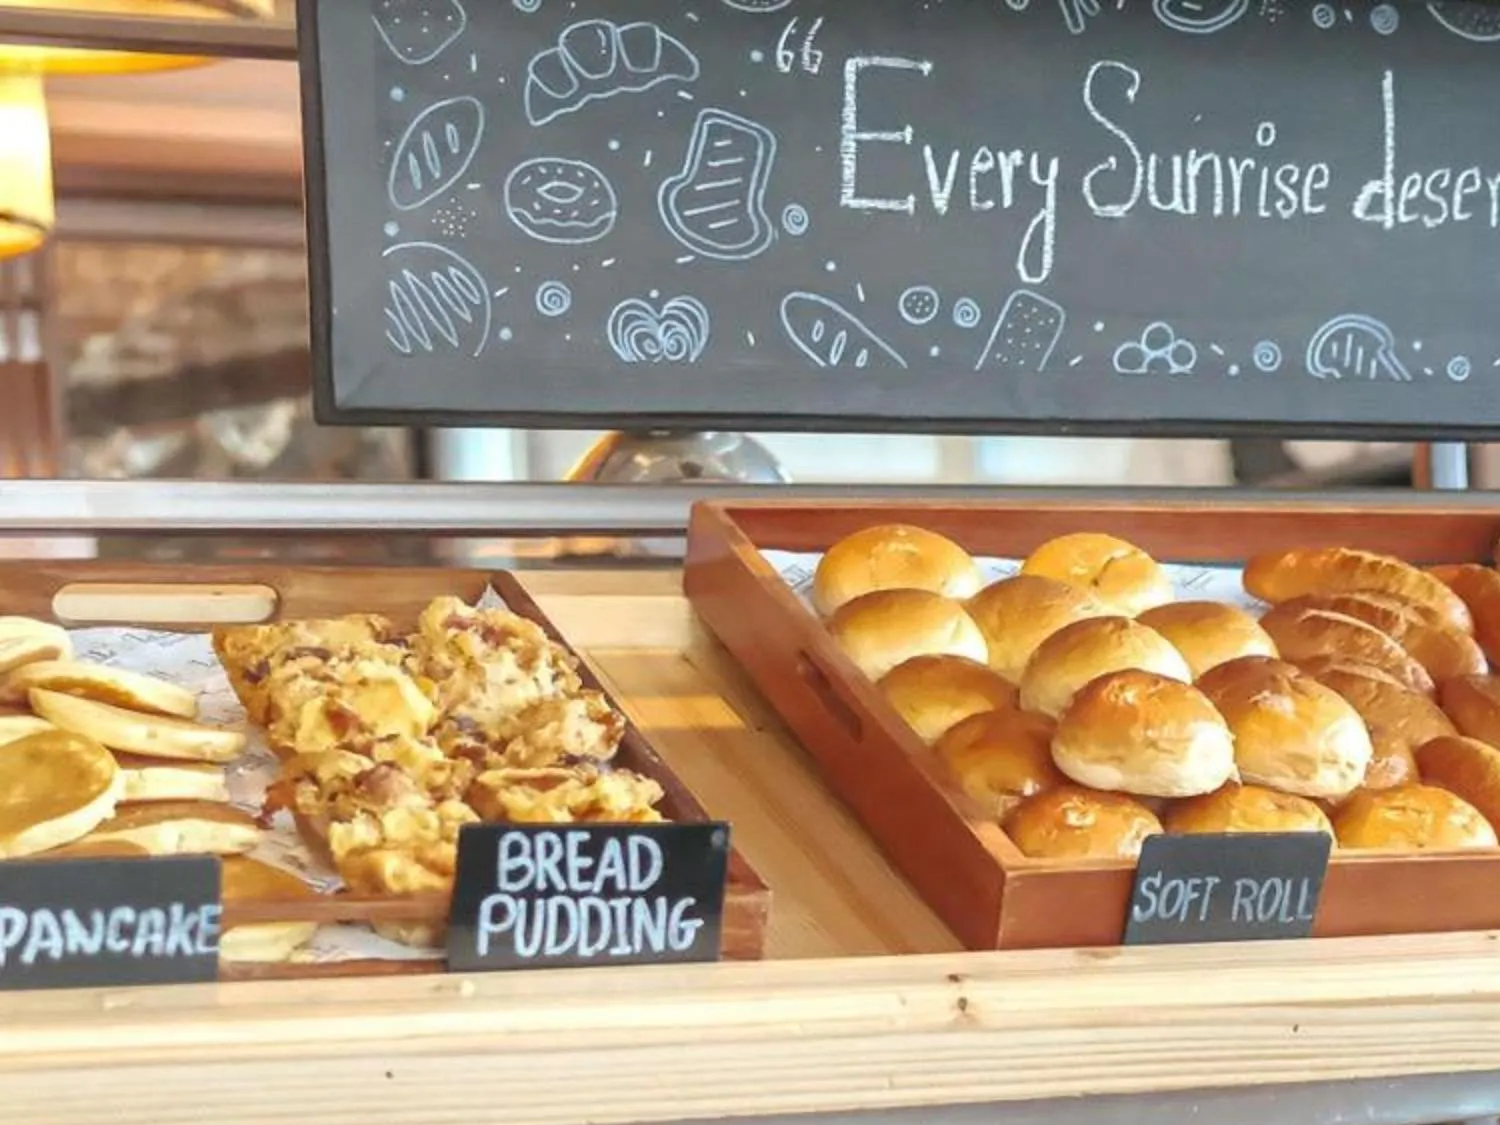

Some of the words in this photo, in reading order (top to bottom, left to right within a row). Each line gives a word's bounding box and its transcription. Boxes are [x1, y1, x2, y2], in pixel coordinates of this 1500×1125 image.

[1082, 60, 1330, 218] Sunrise
[497, 830, 664, 894] BREAD
[476, 892, 705, 958] PUDDING
[1132, 870, 1221, 923] SOFT
[1231, 876, 1314, 923] ROLL
[0, 901, 224, 968] PANCAKE
